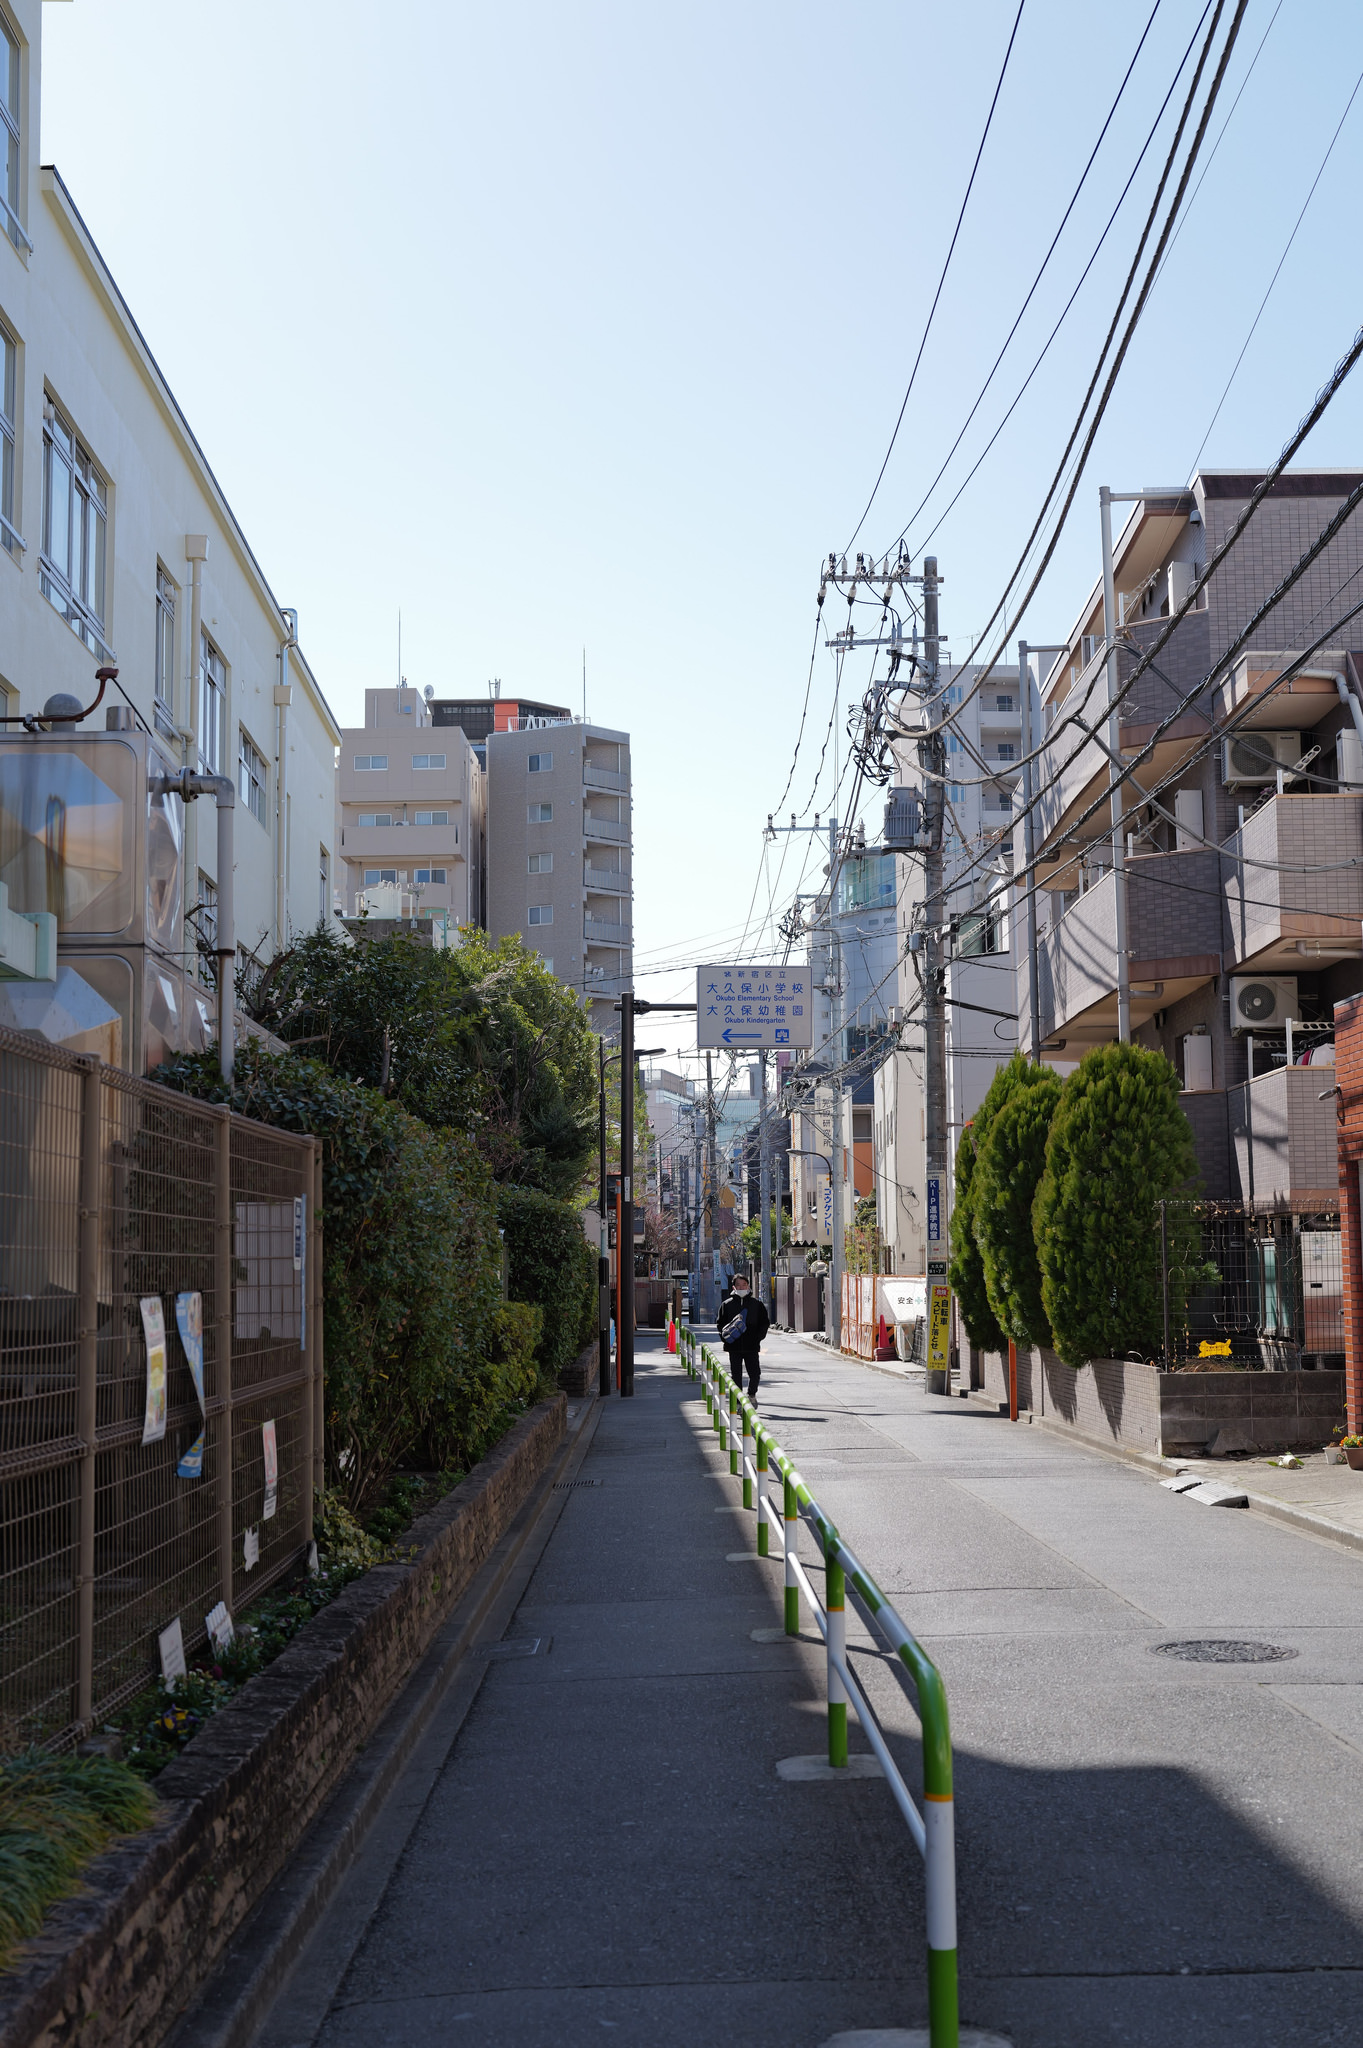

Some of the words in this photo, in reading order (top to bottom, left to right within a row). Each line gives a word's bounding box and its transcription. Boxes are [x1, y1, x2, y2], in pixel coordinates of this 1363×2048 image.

[737, 970, 787, 979] 新宿区立
[706, 982, 804, 994] 大久保小学校
[737, 994, 771, 1003] Elementary
[706, 1004, 804, 1016] 大久保幼稚園
[724, 1016, 744, 1024] Okubo
[746, 1016, 786, 1025] Kindergarten
[823, 1187, 832, 1236] コウケントー
[929, 1180, 938, 1240] KIP進学教室
[897, 1296, 914, 1305] 安全
[939, 1299, 949, 1326] 自転車
[931, 1301, 941, 1350] スピード落とせ
